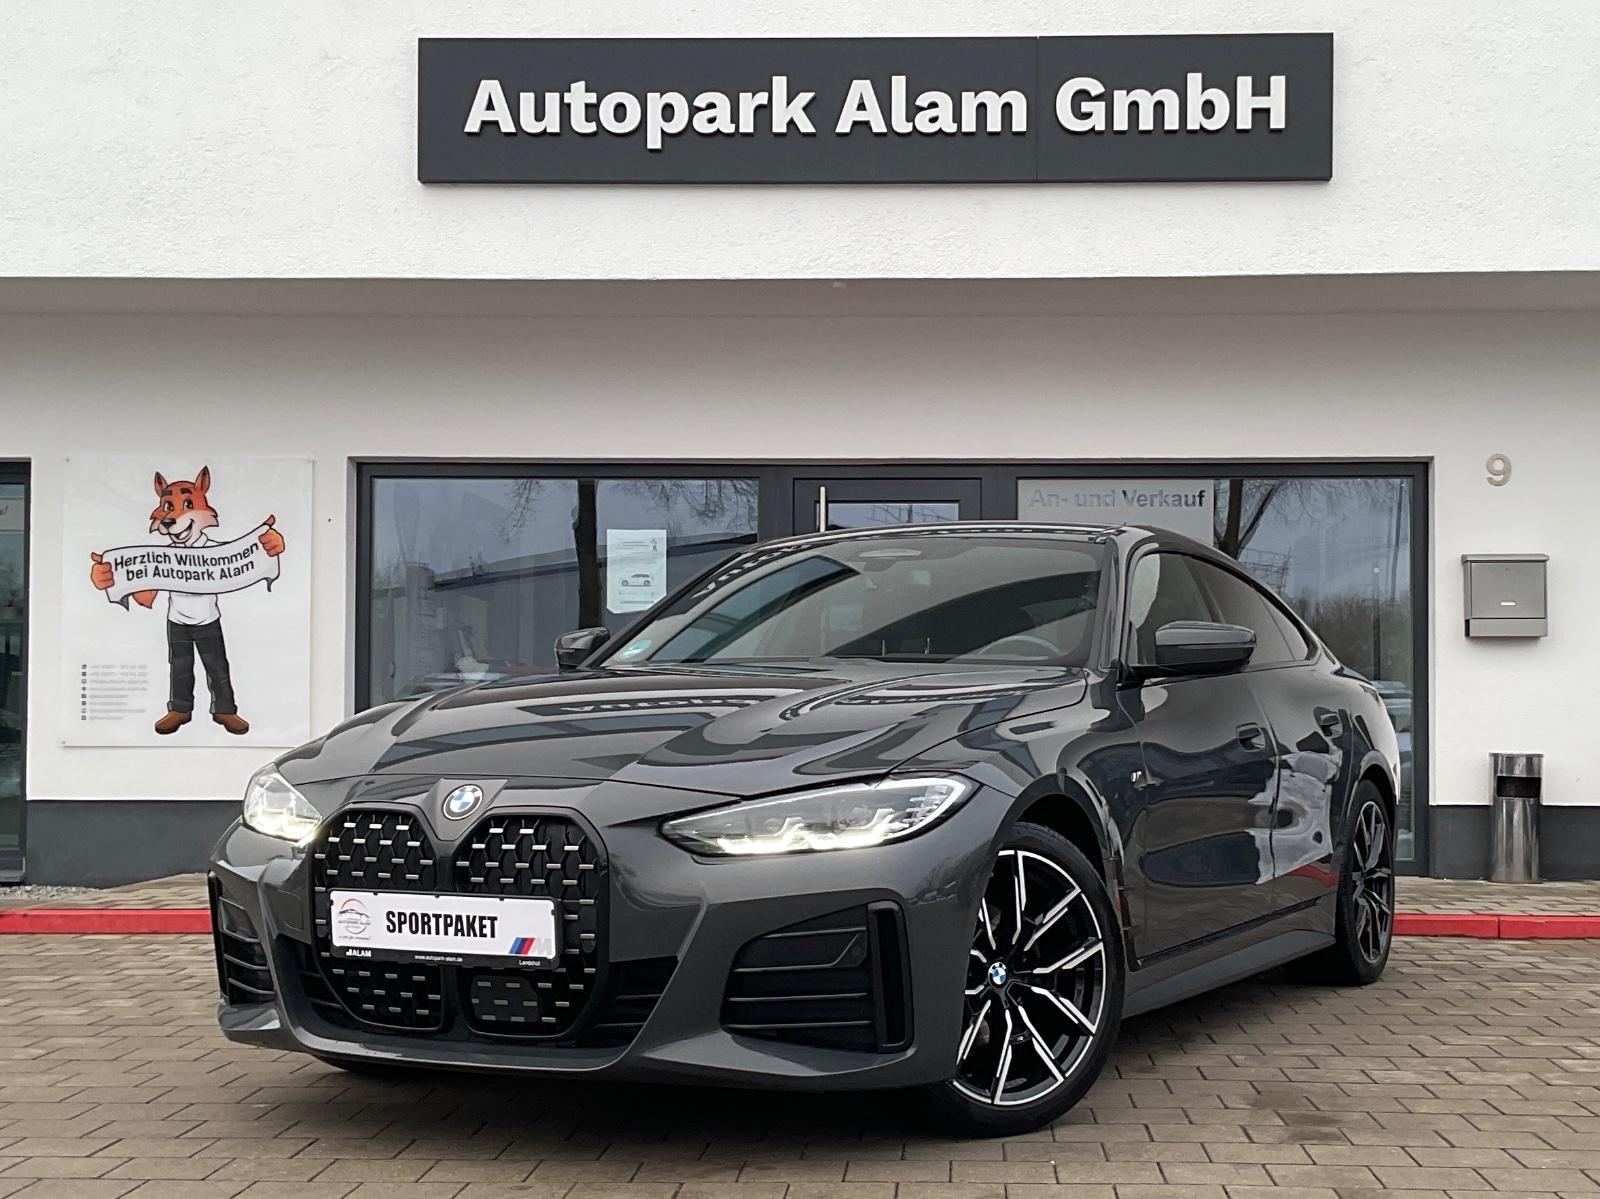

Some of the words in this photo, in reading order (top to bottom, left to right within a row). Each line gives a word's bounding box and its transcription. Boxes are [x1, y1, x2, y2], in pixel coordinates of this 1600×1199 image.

[464, 76, 816, 150] Autopark
[836, 76, 1027, 134] Alam
[1056, 73, 1287, 132] GmbH
[1485, 453, 1512, 486] 9
[1029, 489, 1068, 507] An-
[1074, 489, 1115, 507] und
[1121, 489, 1206, 507] Verkauf
[114, 552, 171, 571] Herzlich
[174, 541, 260, 567] Willkommen
[126, 565, 148, 581] bei
[152, 565, 215, 582] Autopark
[219, 559, 255, 580] Alam
[386, 910, 498, 938] SPORTPAKET
